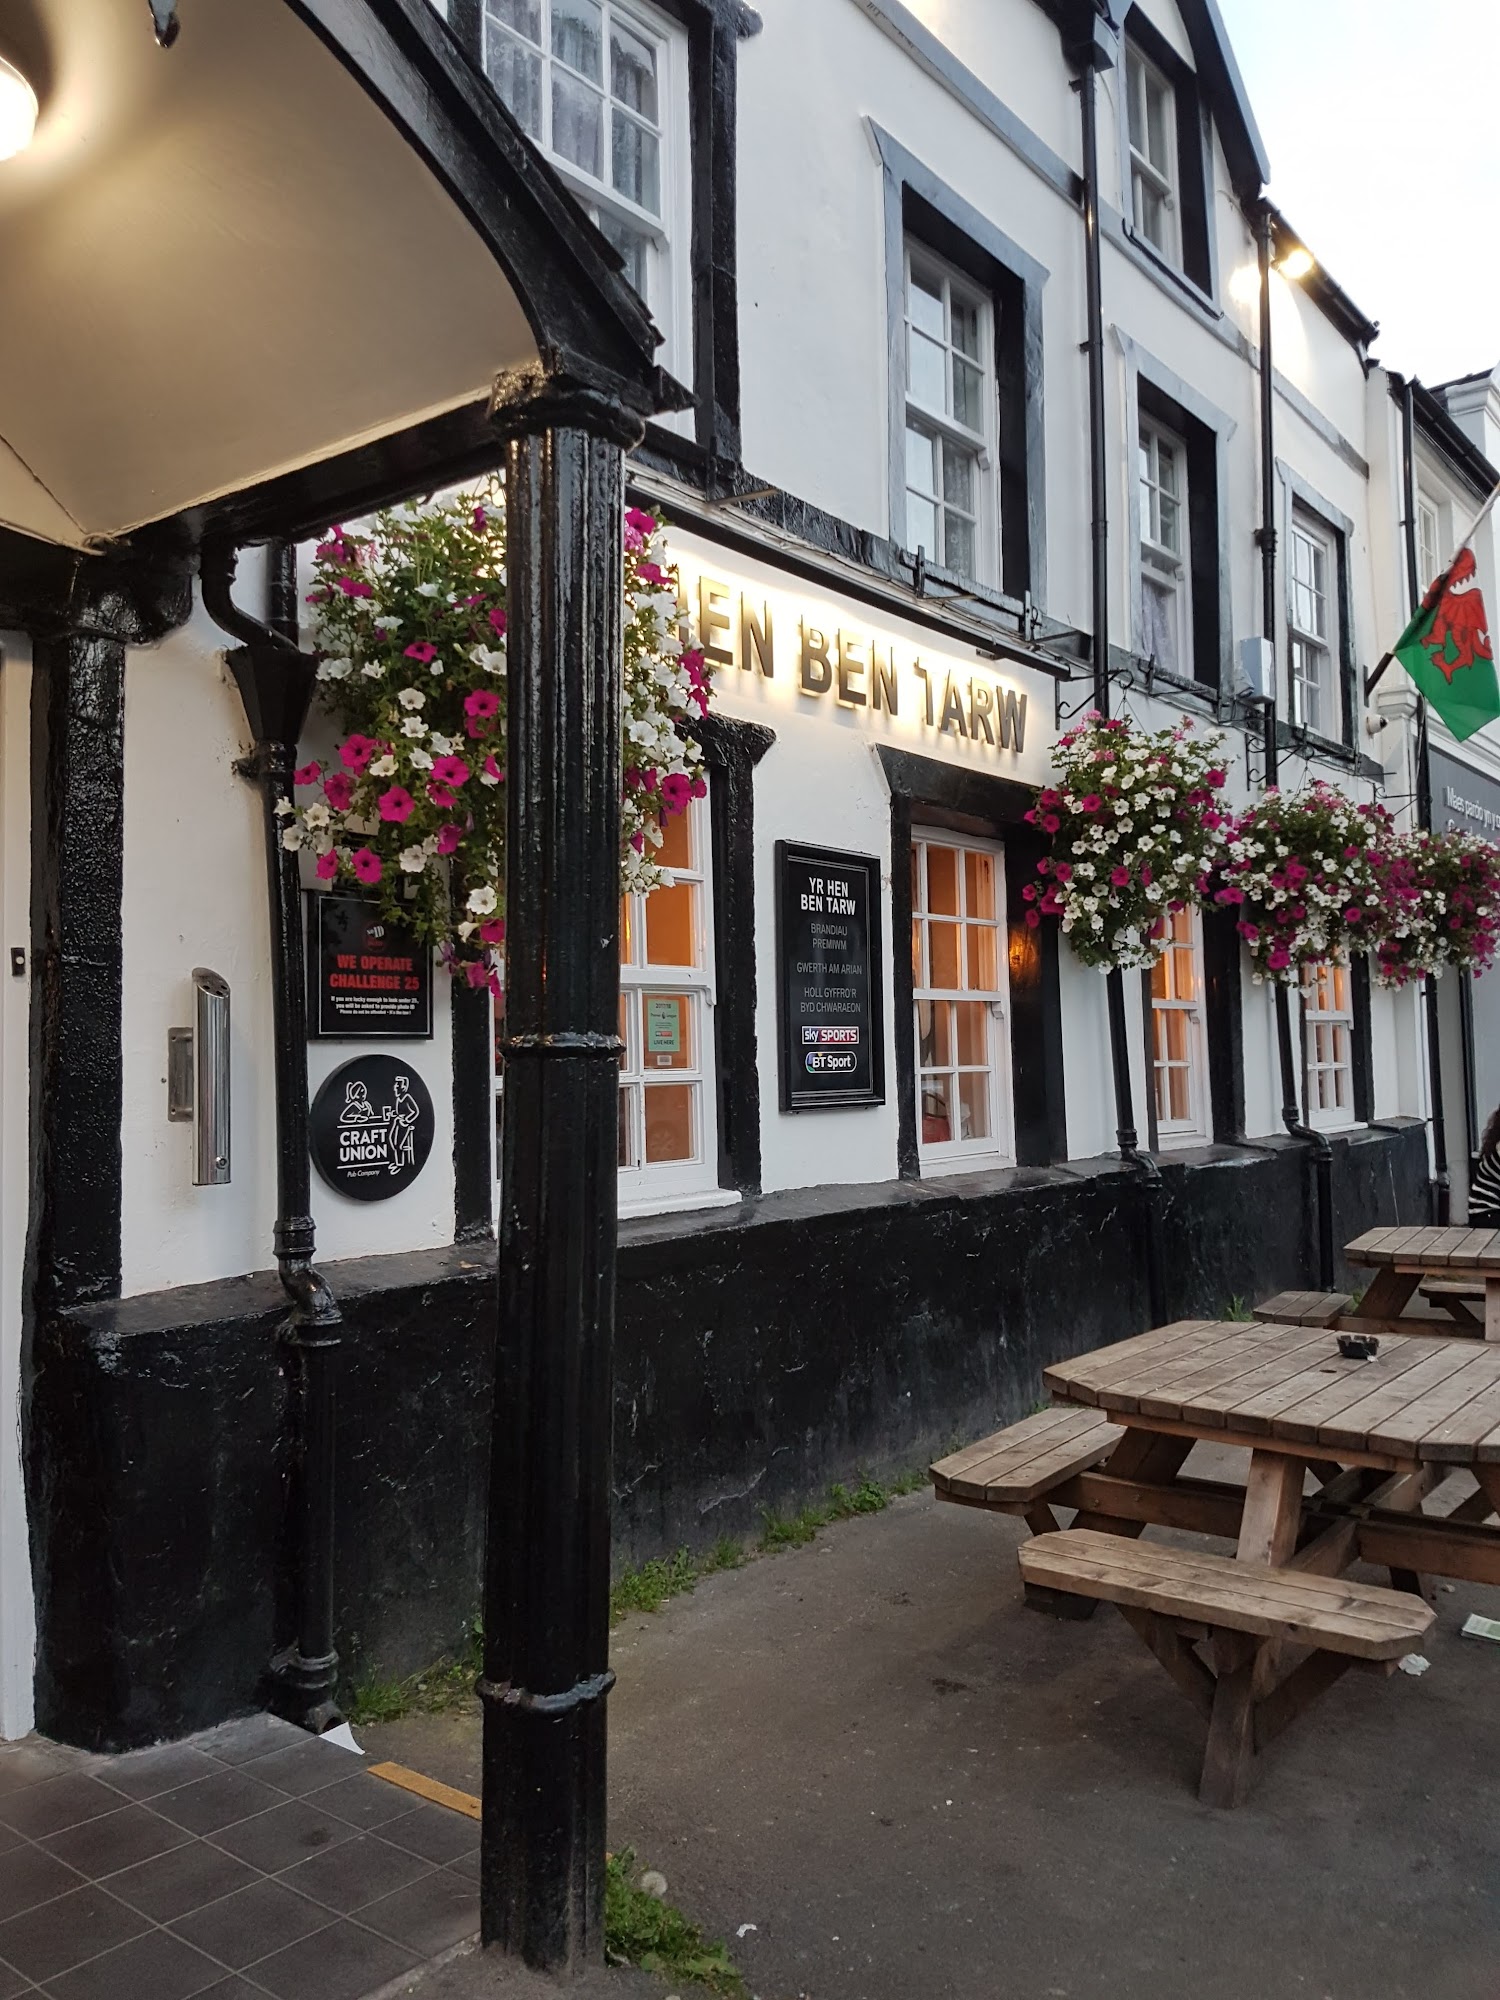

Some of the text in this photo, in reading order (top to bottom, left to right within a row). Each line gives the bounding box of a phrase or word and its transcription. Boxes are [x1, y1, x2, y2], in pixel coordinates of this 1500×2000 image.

[801, 614, 898, 716] BEN
[914, 657, 1028, 754] TARW
[808, 877, 849, 897] YR HEN
[800, 893, 856, 915] BEN TARW
[810, 923, 848, 936] BRANDIAU
[812, 938, 847, 950] PREMIWM
[336, 954, 413, 971] WE OPERATE
[796, 962, 862, 975] GWERTH AM ARIAN
[329, 973, 420, 991] CHALLENGE 25
[804, 987, 823, 998] HOLL
[800, 1002, 861, 1013] BYD CHWARAEON
[804, 1028, 857, 1042] sky SPORTS
[812, 1055, 851, 1070] BT Sport
[339, 1128, 388, 1146] CRAFT
[339, 1144, 388, 1162] UNION
